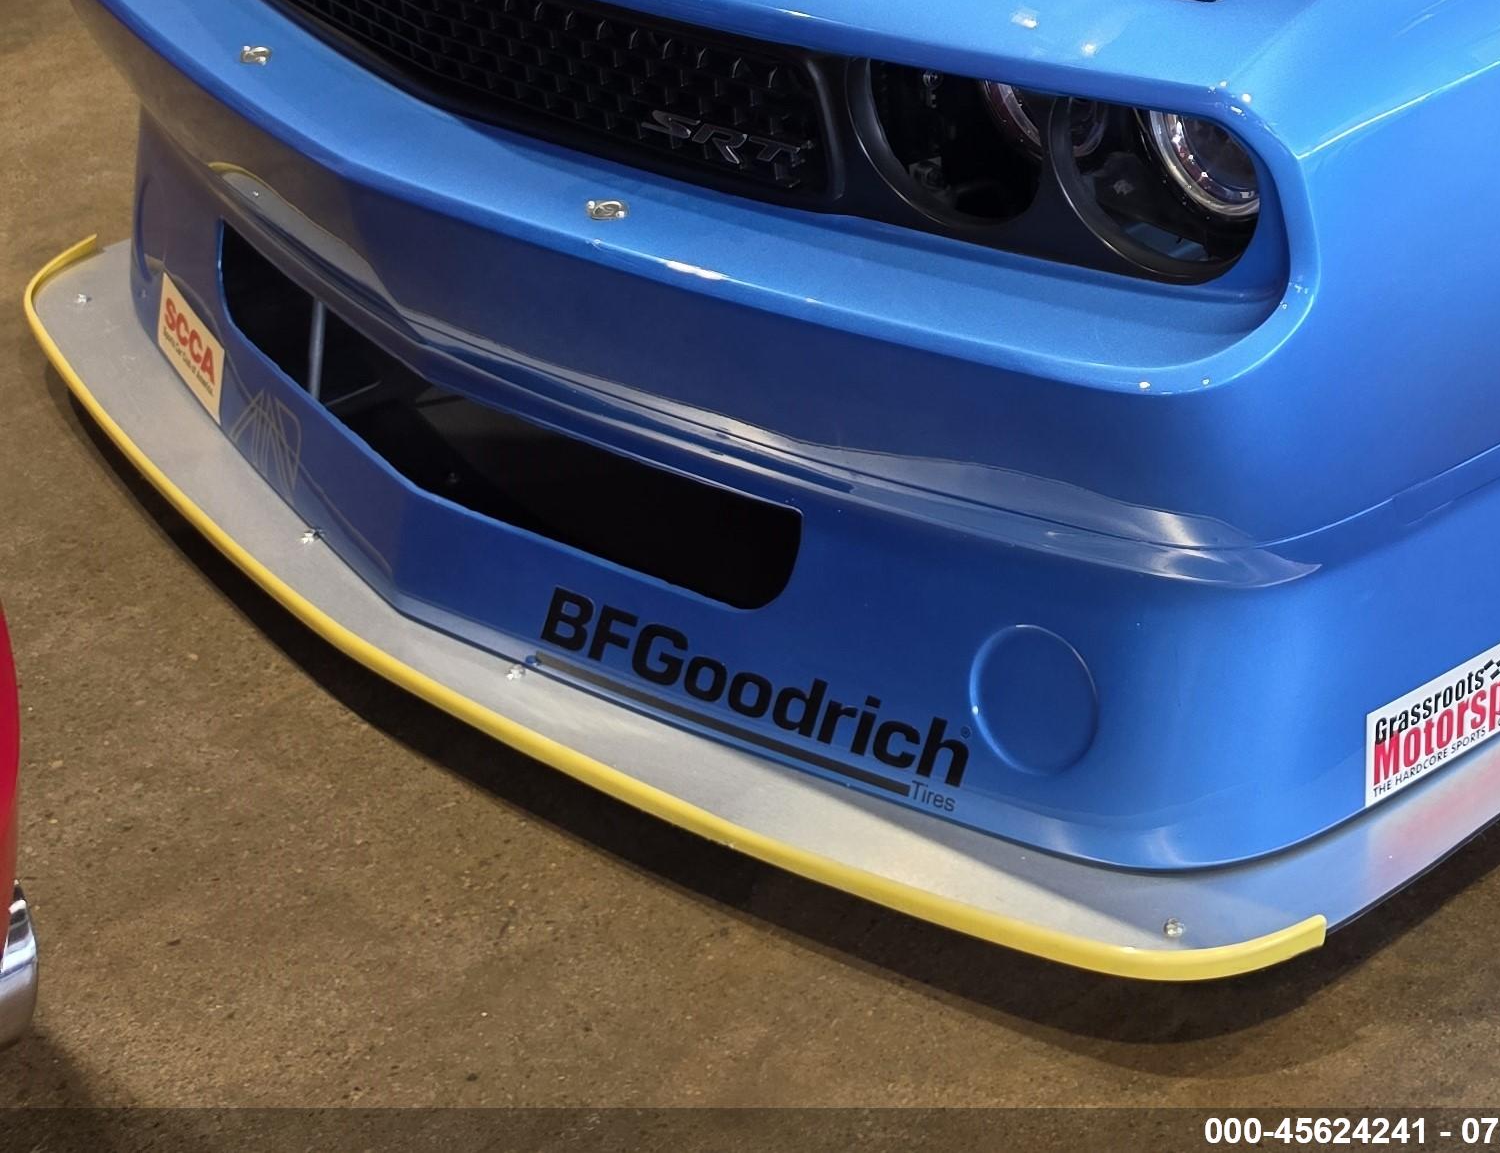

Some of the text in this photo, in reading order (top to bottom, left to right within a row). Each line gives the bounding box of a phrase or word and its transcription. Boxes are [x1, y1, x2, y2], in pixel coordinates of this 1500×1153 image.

[641, 109, 800, 164] SRT
[164, 297, 215, 385] SCCA
[540, 587, 971, 786] BFGoodrich
[1375, 667, 1485, 745] Grassroots
[910, 779, 956, 813] Tires
[1373, 783, 1392, 797] THE
[1395, 750, 1449, 786] HARDCORE
[1451, 726, 1486, 754] SPORTS
